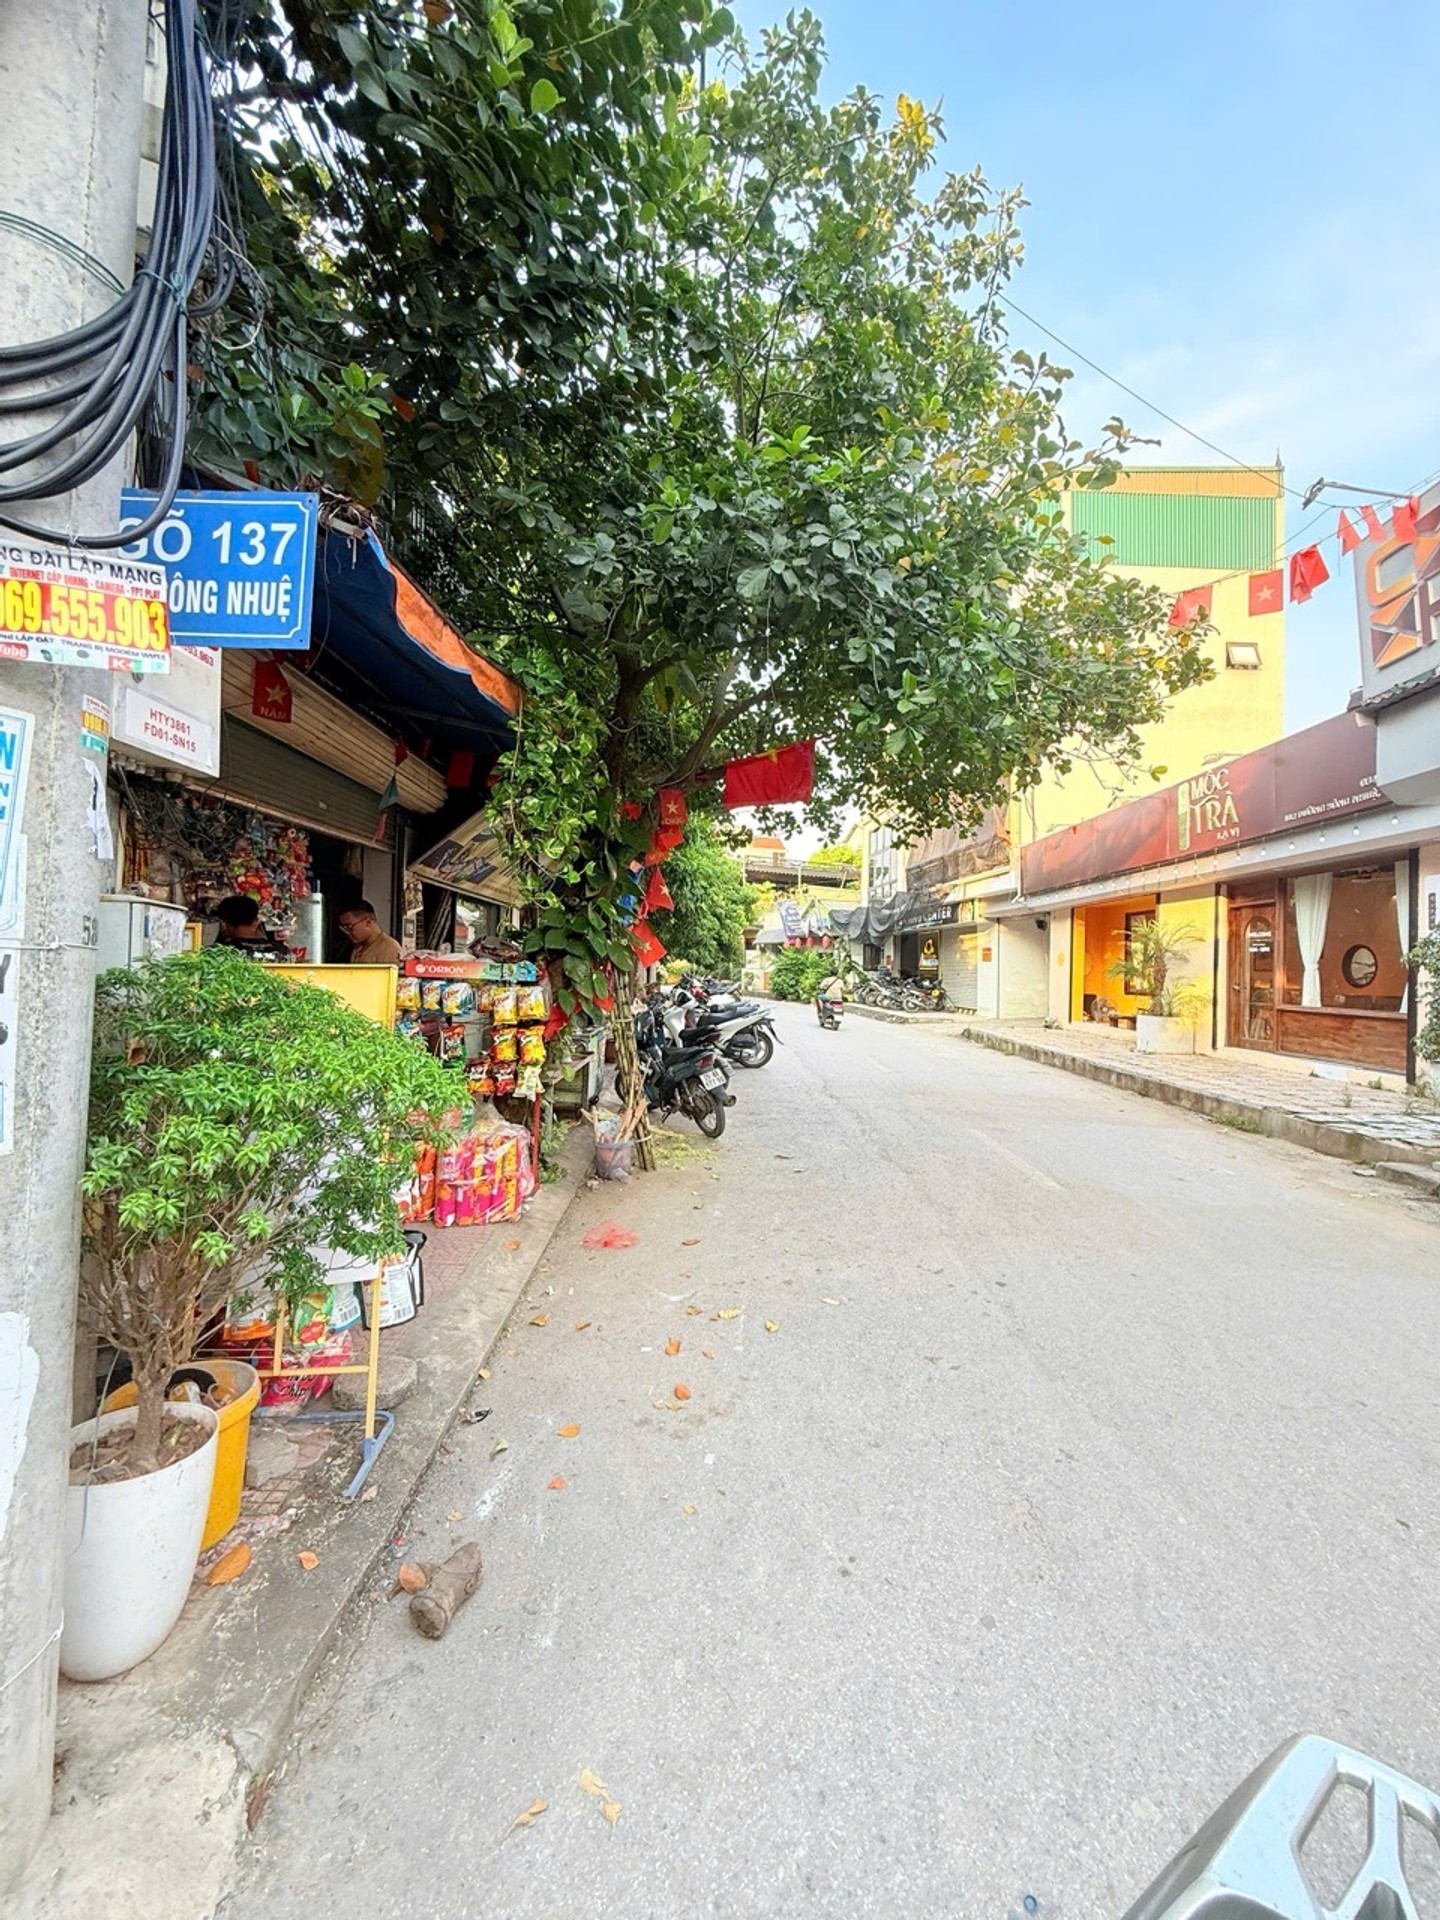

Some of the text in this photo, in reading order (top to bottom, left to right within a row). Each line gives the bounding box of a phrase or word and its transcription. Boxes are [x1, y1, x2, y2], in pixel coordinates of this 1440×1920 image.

[212, 521, 298, 566] 137
[109, 564, 162, 585] MẠNG
[0, 578, 166, 651] 69.555.903
[226, 574, 293, 624] NHUỆ
[143, 722, 197, 753] FD01-SN15
[149, 708, 191, 736] HTY3861
[428, 965, 464, 975] ORION
